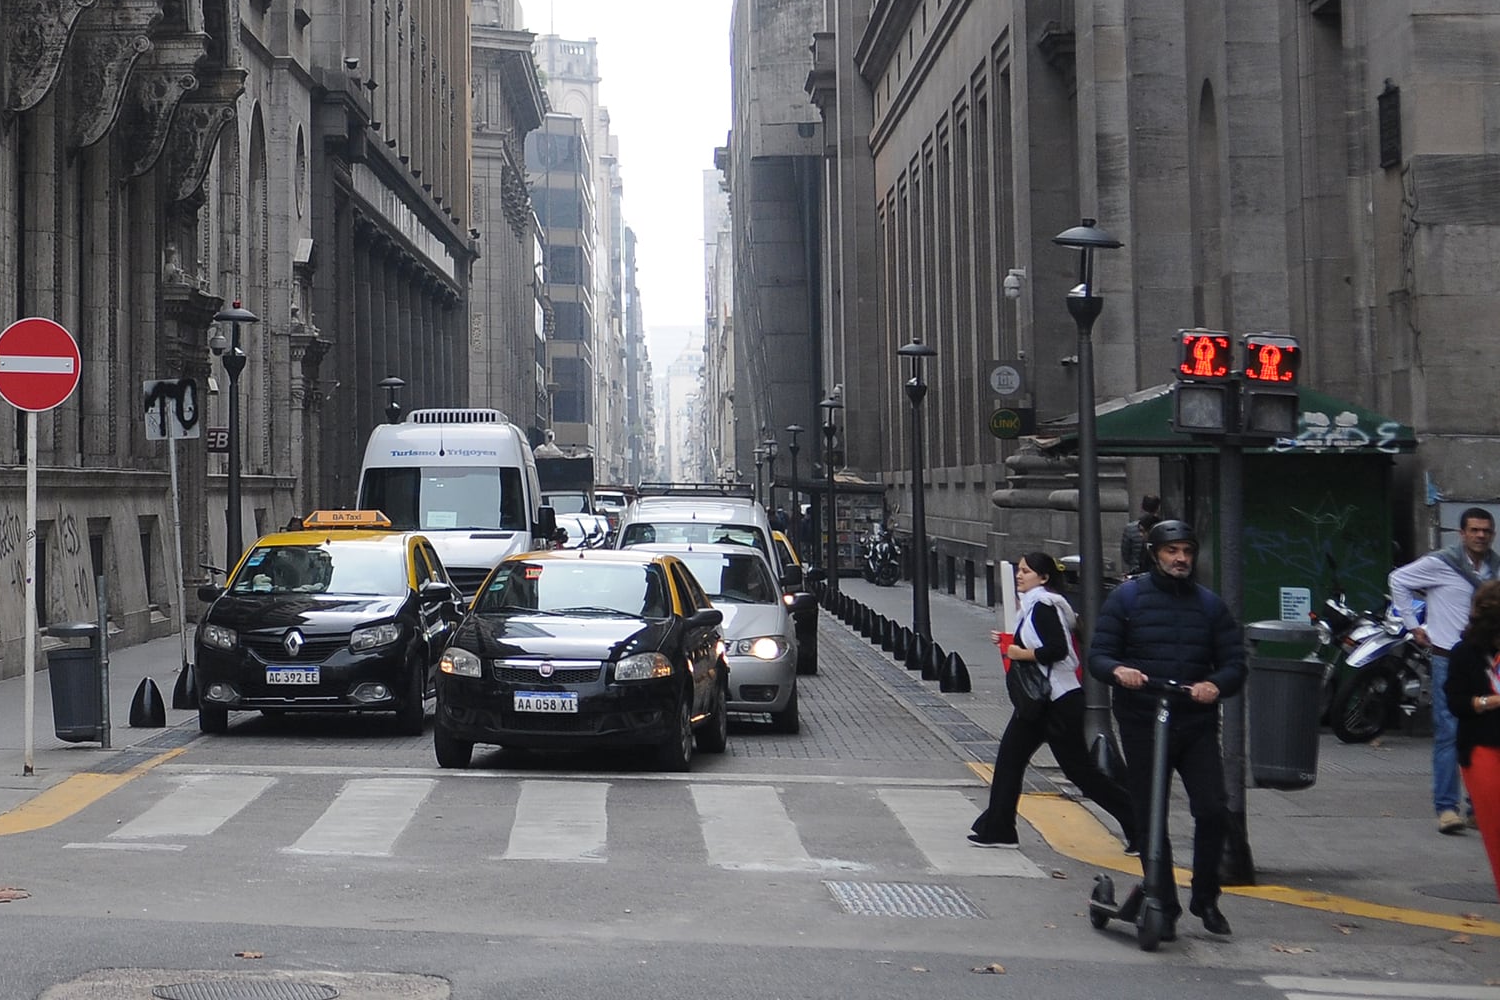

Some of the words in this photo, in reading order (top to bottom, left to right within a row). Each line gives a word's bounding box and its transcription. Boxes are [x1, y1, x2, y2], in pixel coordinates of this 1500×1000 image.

[993, 418, 1020, 429] LINK
[390, 449, 437, 458] Turismo
[332, 513, 345, 521] BA
[346, 513, 362, 521] Taxi
[269, 672, 281, 683] AC
[283, 672, 303, 683] 392
[304, 672, 318, 683] EE
[517, 698, 532, 710] AA
[535, 699, 557, 711] 058
